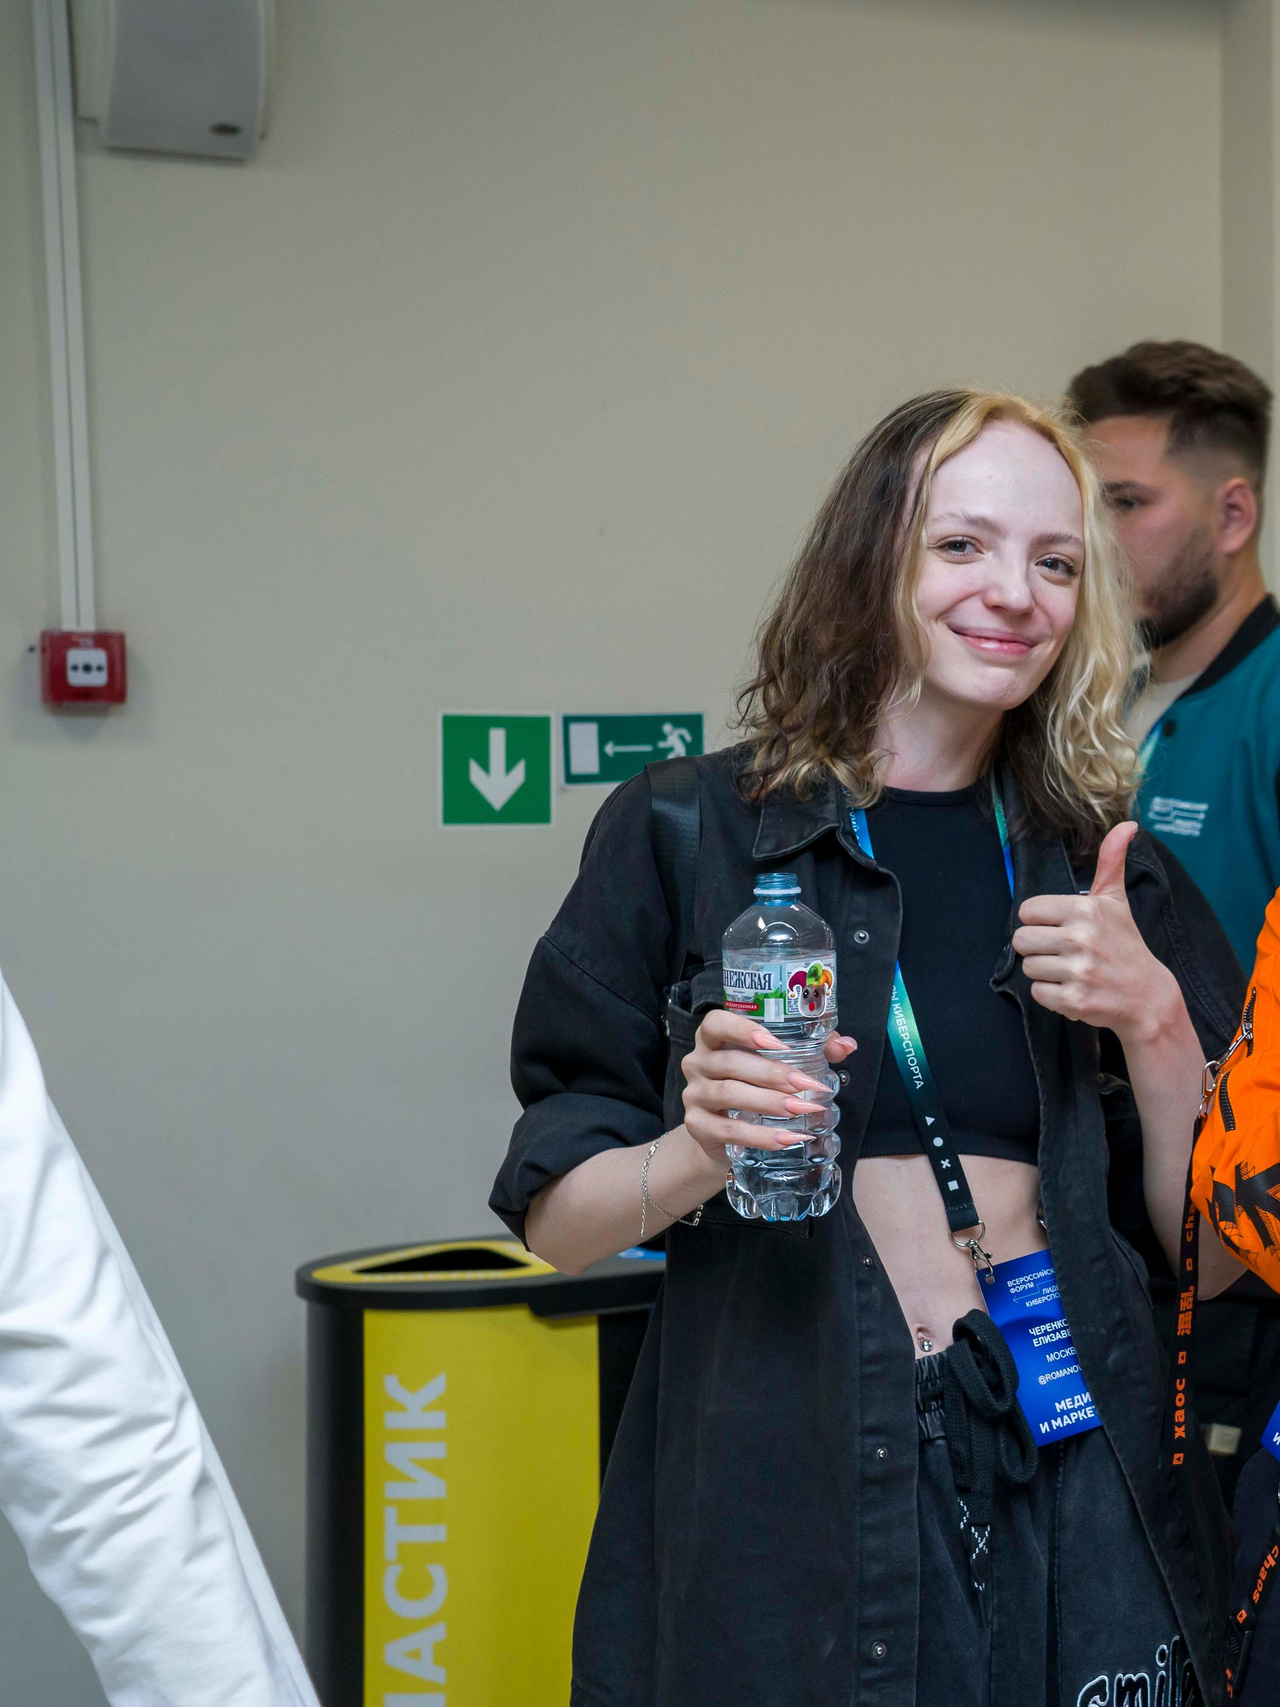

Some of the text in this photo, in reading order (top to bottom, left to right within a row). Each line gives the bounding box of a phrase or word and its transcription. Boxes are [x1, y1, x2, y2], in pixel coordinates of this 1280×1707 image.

[892, 1002, 924, 1089] КИБЕРСПОРТА
[1010, 1282, 1034, 1294] ФОРУМ
[1039, 1405, 1095, 1434] И МАРКЕ
[1055, 1391, 1092, 1413] МЕДИ
[383, 1372, 447, 1707] АСТИК
[1252, 1545, 1279, 1604] chaos
